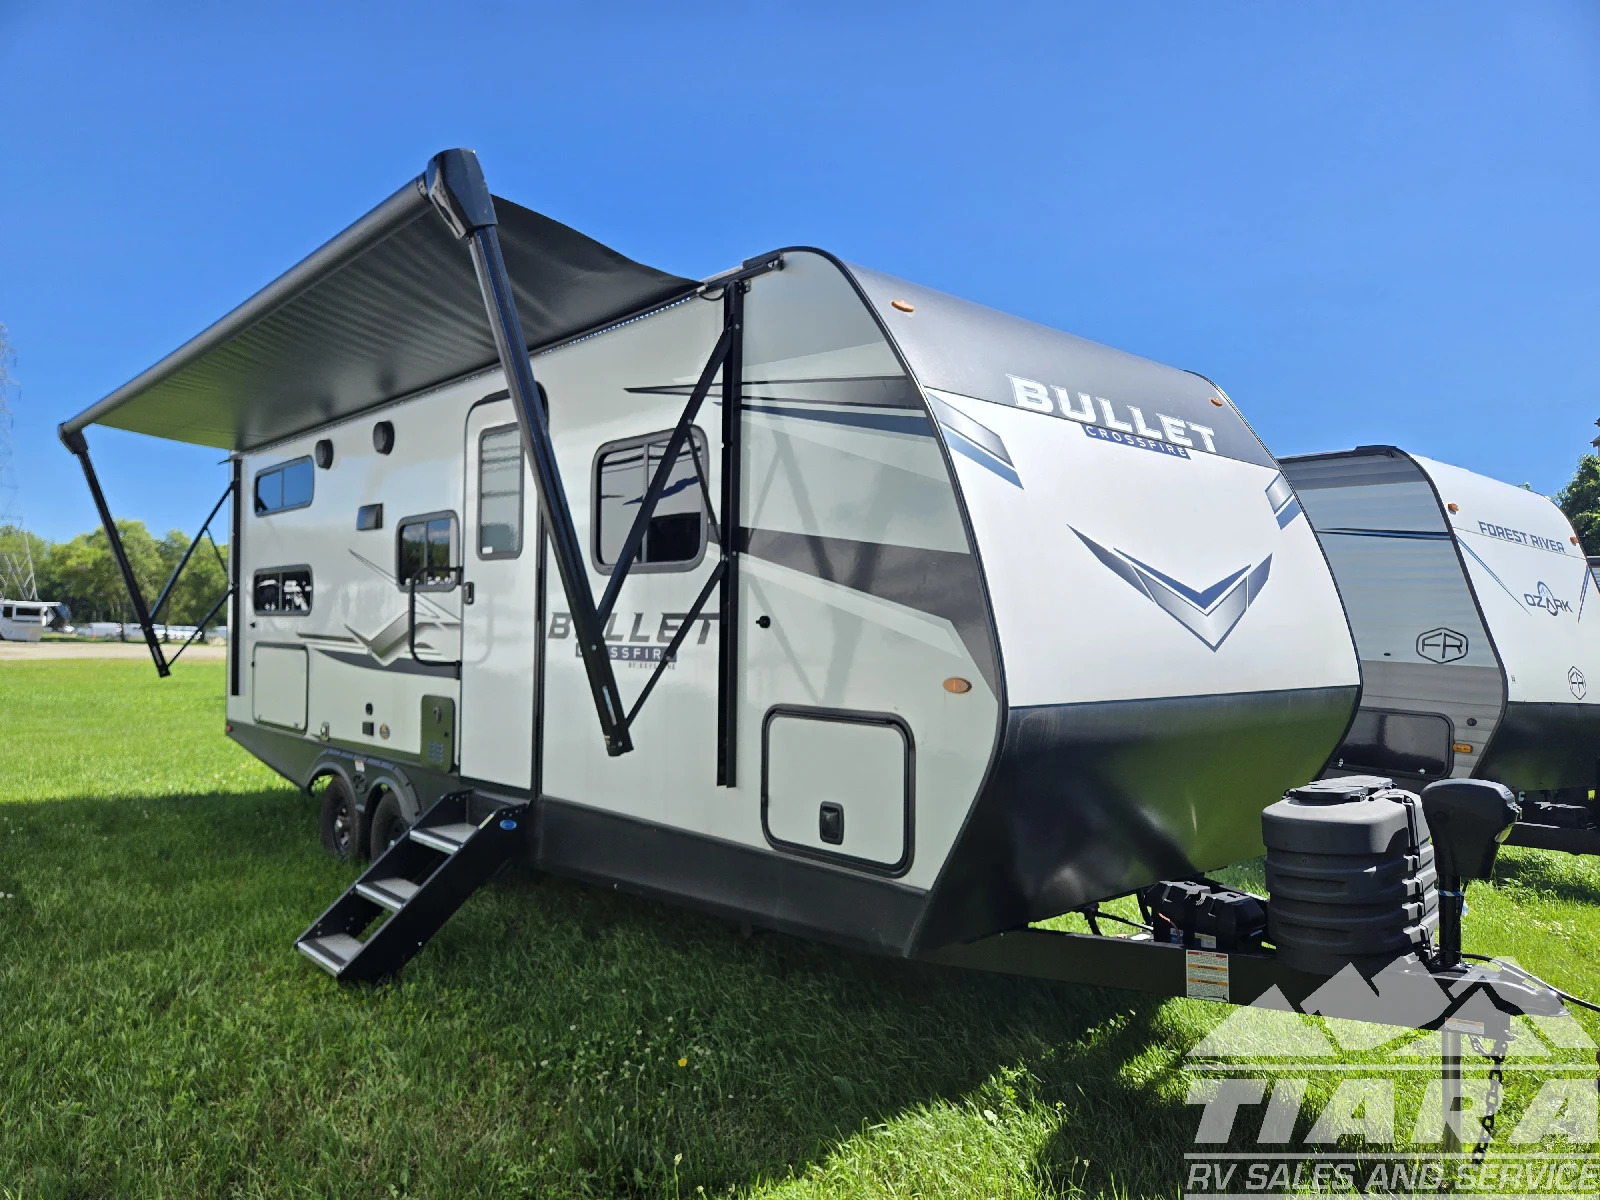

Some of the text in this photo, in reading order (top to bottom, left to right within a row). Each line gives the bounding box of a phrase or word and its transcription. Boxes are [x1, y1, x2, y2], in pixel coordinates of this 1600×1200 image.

[1006, 373, 1217, 453] BULLET
[1085, 425, 1187, 457] CROSSFIRE
[1477, 520, 1566, 554] FOREST RIVER
[1523, 589, 1574, 615] OZARK
[548, 612, 720, 644] BLLET
[578, 646, 673, 662] SSFIR
[628, 661, 637, 669] BY
